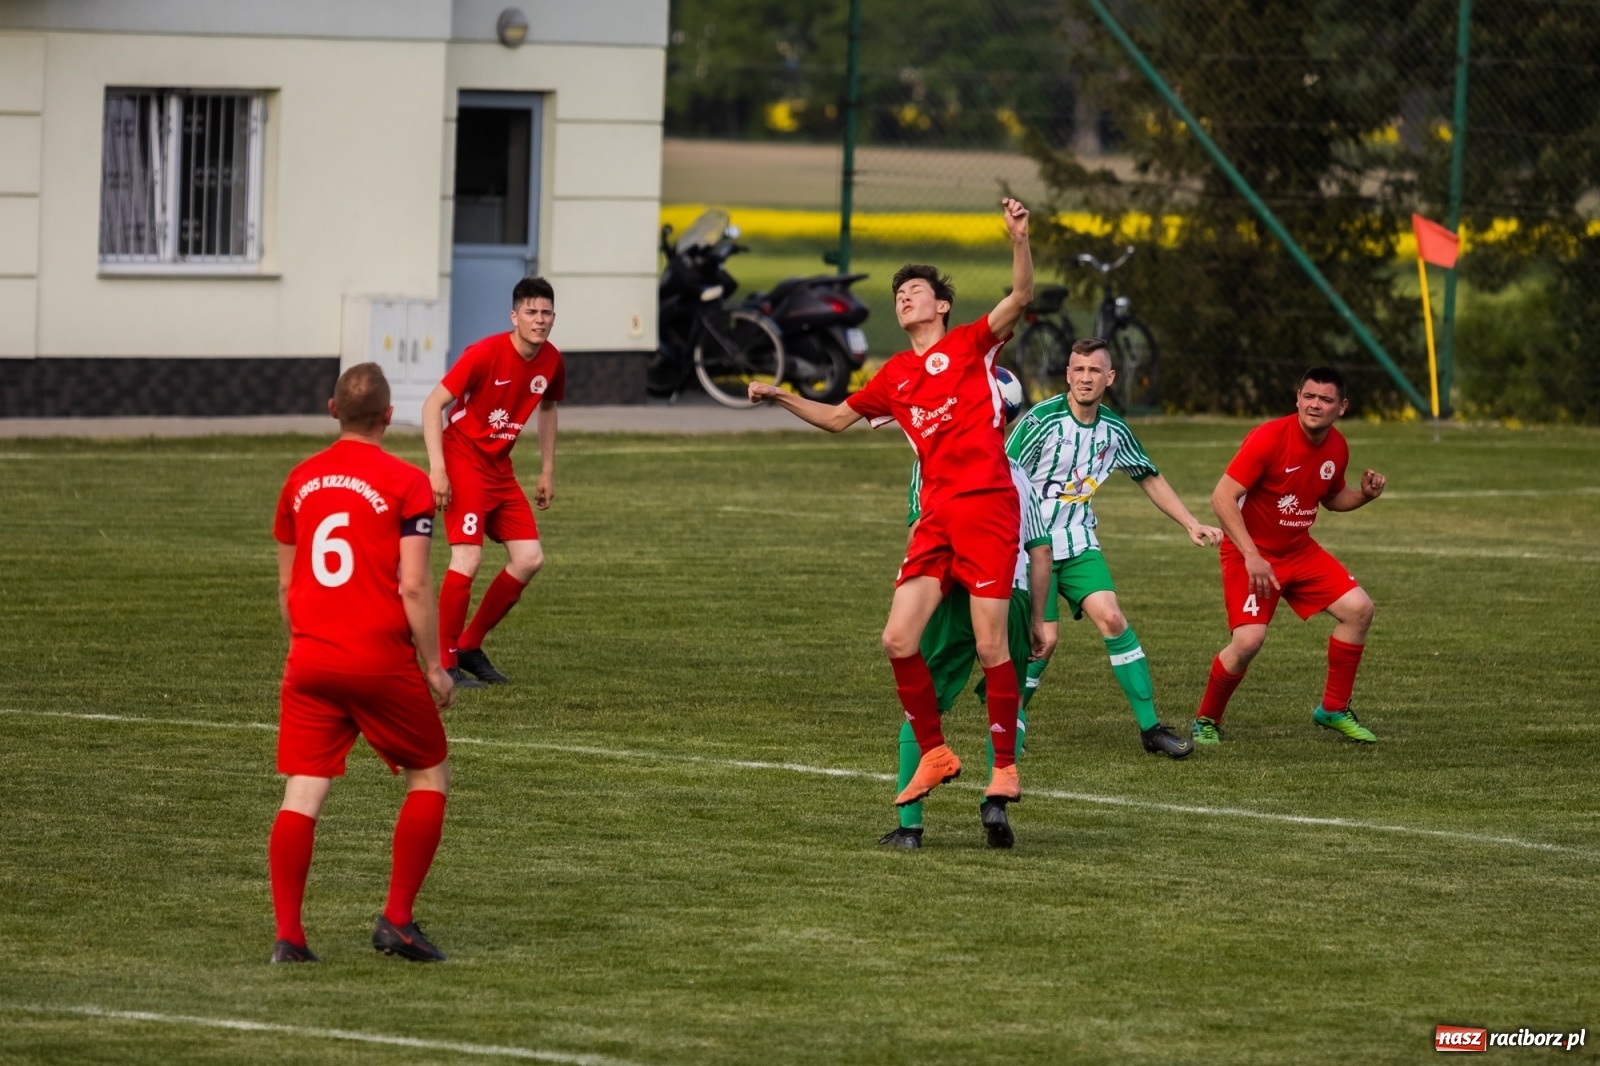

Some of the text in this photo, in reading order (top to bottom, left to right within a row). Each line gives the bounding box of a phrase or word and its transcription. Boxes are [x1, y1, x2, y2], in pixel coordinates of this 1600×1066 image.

[299, 476, 321, 500] 1905
[322, 474, 389, 515] KRZANOWICE
[415, 518, 432, 534] C
[462, 512, 478, 536] 8
[311, 511, 355, 588] 6
[1242, 593, 1260, 617] 4
